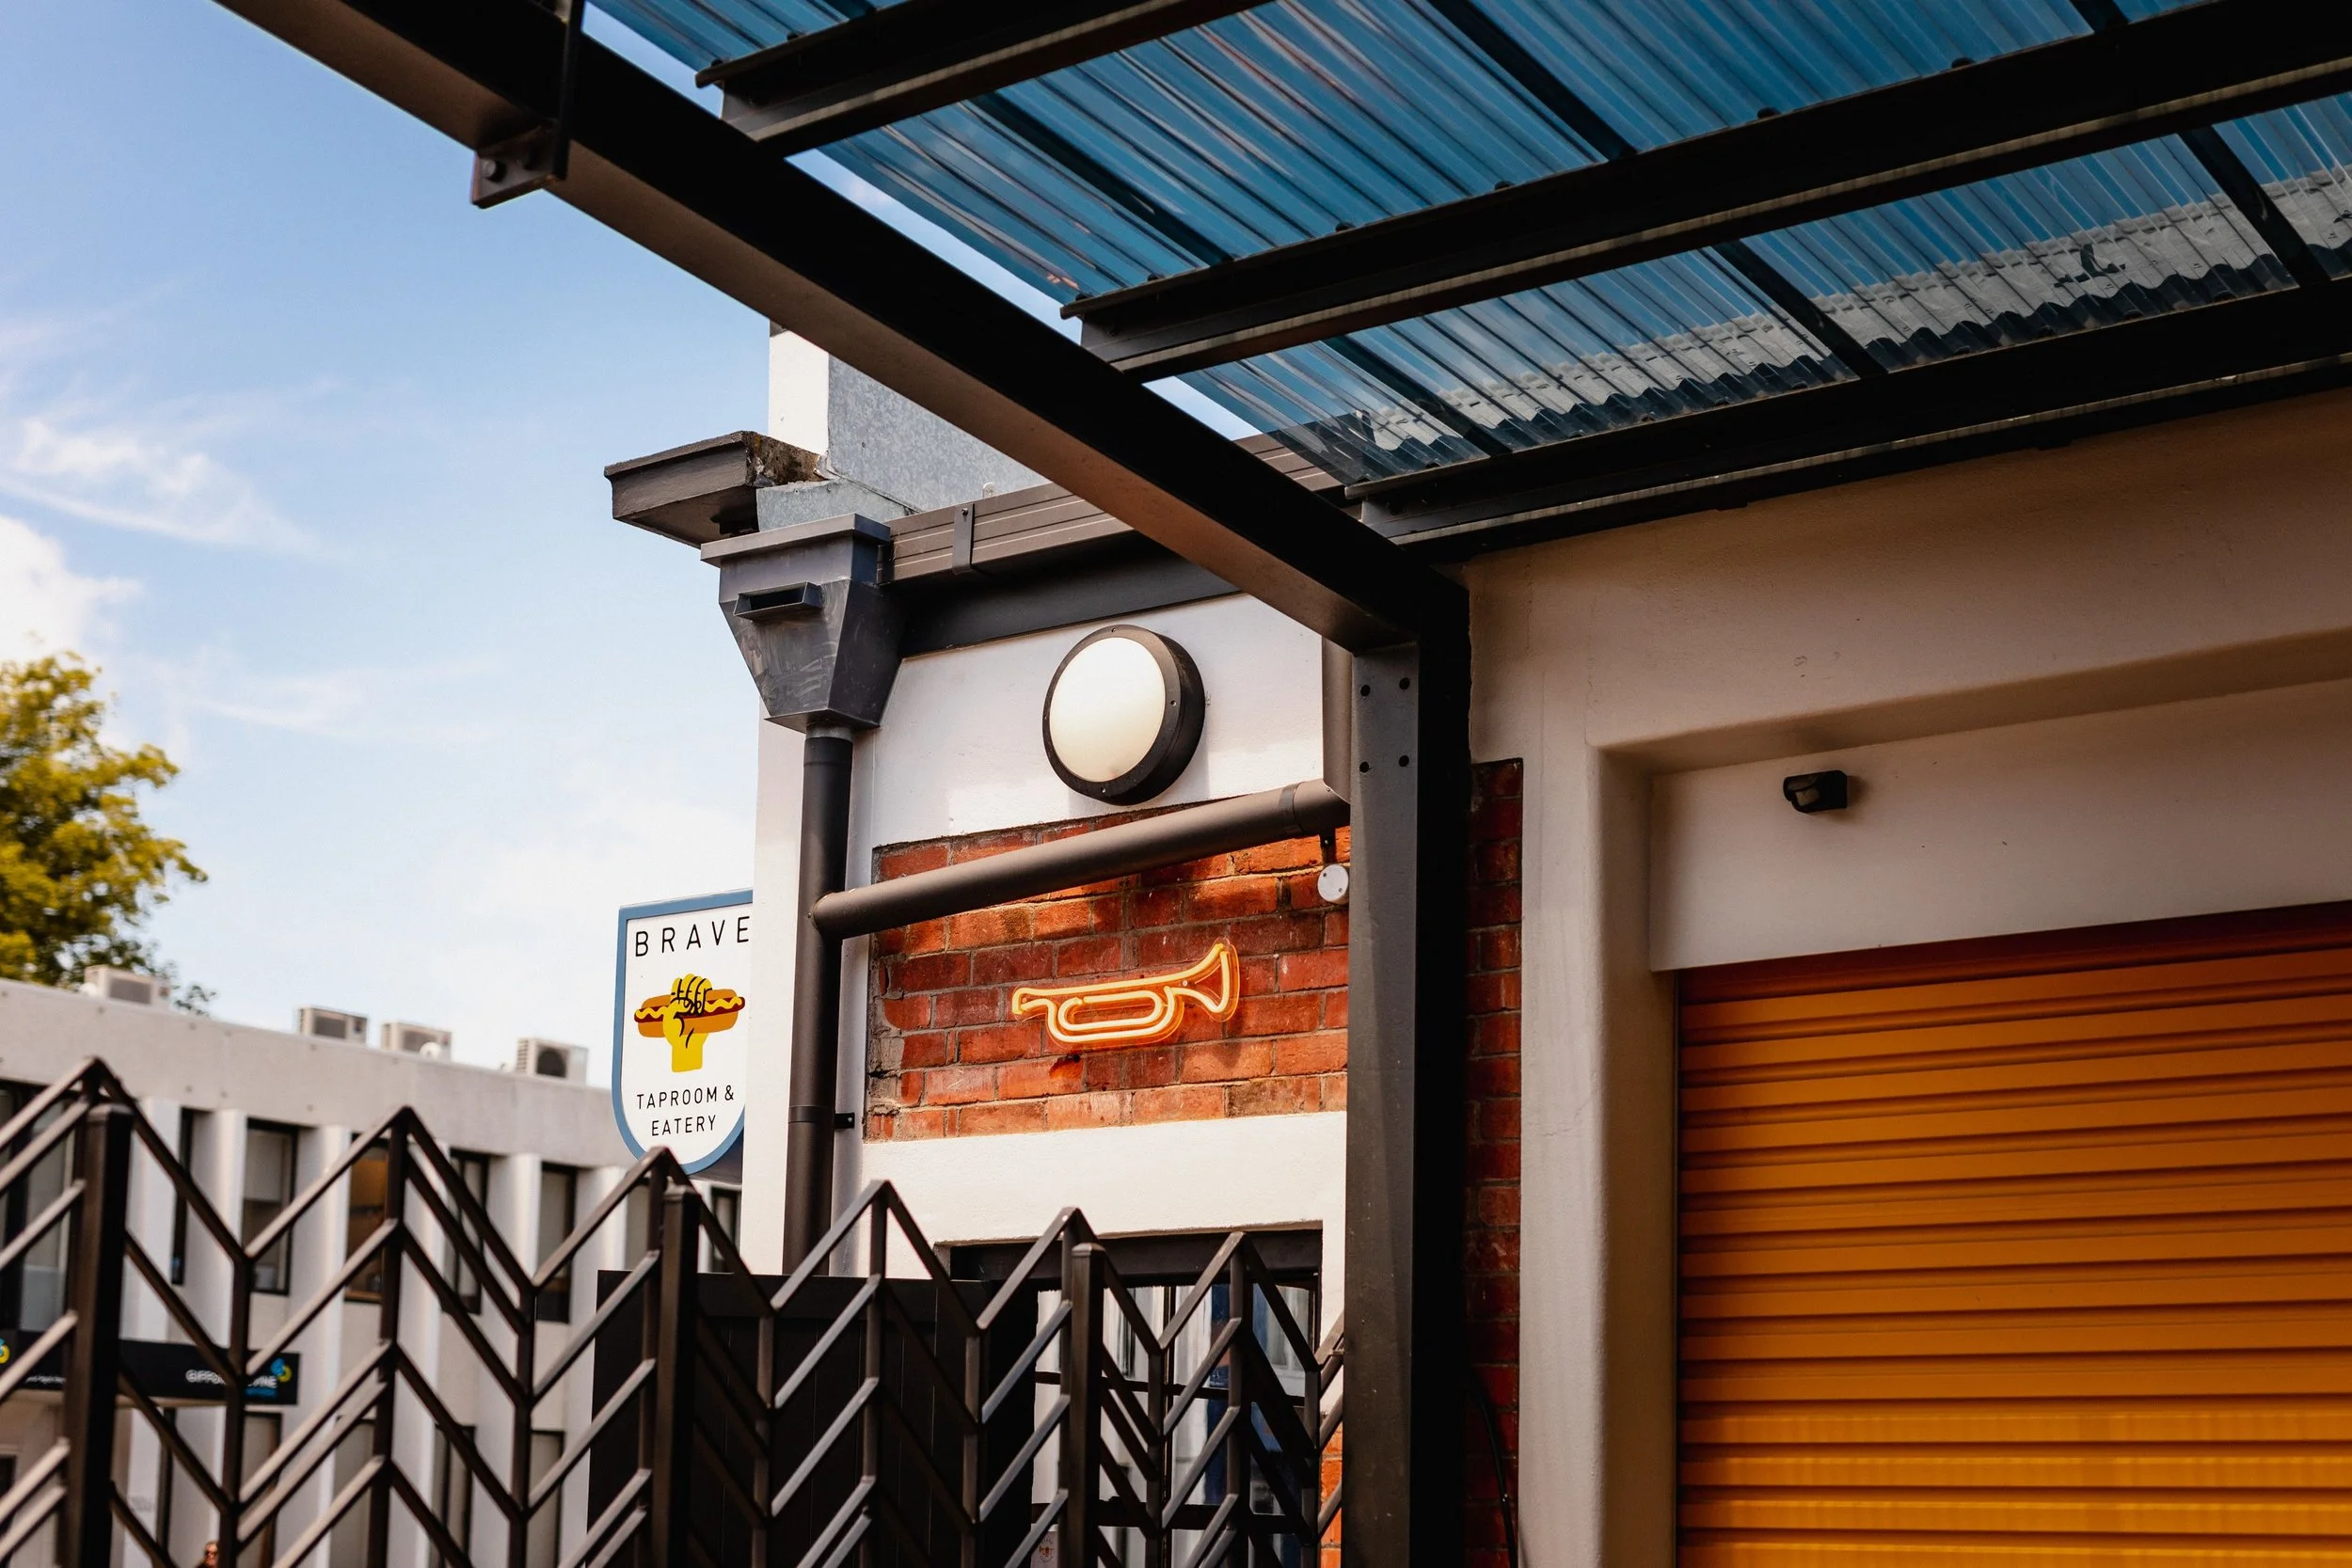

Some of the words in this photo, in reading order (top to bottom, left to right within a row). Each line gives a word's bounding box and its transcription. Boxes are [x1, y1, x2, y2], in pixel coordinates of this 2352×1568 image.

[635, 916, 750, 957] BRAVE
[637, 1086, 717, 1109] TAPROOM
[724, 1085, 734, 1101] &
[652, 1116, 715, 1136] EATERY
